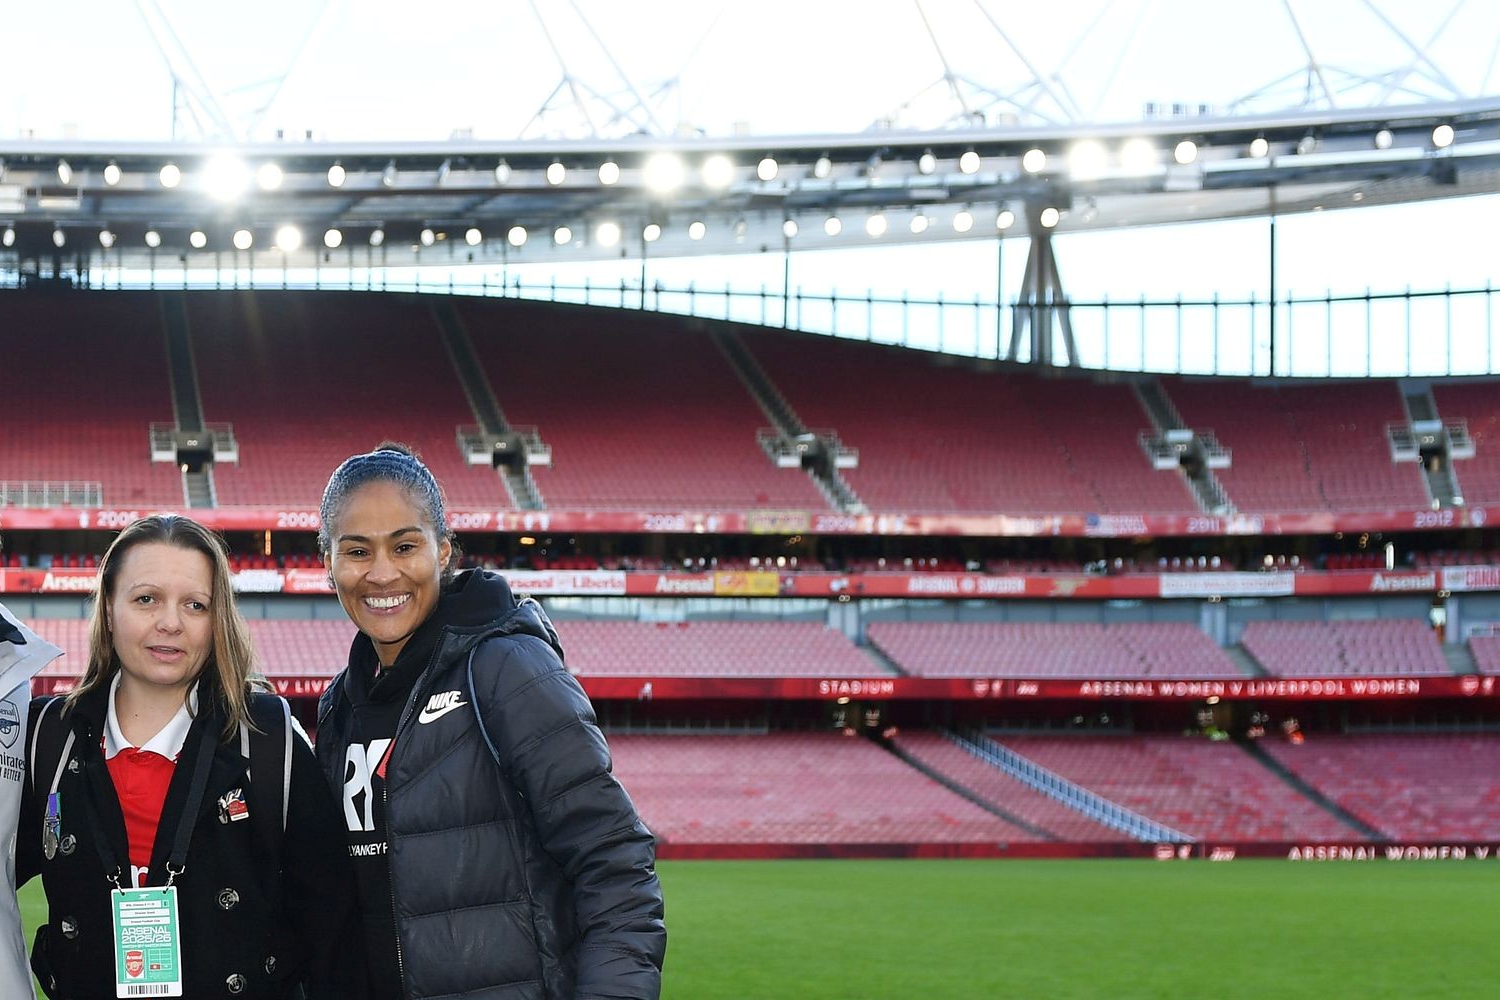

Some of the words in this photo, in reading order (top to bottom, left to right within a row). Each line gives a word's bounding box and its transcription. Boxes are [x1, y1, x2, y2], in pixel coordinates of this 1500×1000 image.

[277, 512, 320, 528] 2006
[451, 513, 492, 529] 2007
[1187, 517, 1220, 532] 2011
[1413, 511, 1453, 528] 2012
[41, 572, 100, 591] Arsena
[509, 577, 553, 588] rsenal
[655, 575, 714, 593] Arsenal
[1370, 572, 1435, 591] Arsenal
[820, 680, 894, 694] STADIUM
[1080, 681, 1154, 695] ARSENAL
[1158, 681, 1225, 696] WOMEN
[1230, 681, 1243, 695] V
[1247, 681, 1346, 696] LIVERPOOL
[1353, 680, 1420, 695] WOMEN
[427, 690, 462, 711] NIKE
[3, 768, 21, 783] BETTER
[348, 843, 382, 857] .YANKEY
[1288, 846, 1375, 862] ARSENAL
[1384, 846, 1467, 861] WOMEN
[122, 926, 171, 936] ARSENAL
[122, 934, 171, 944] 2025/26
